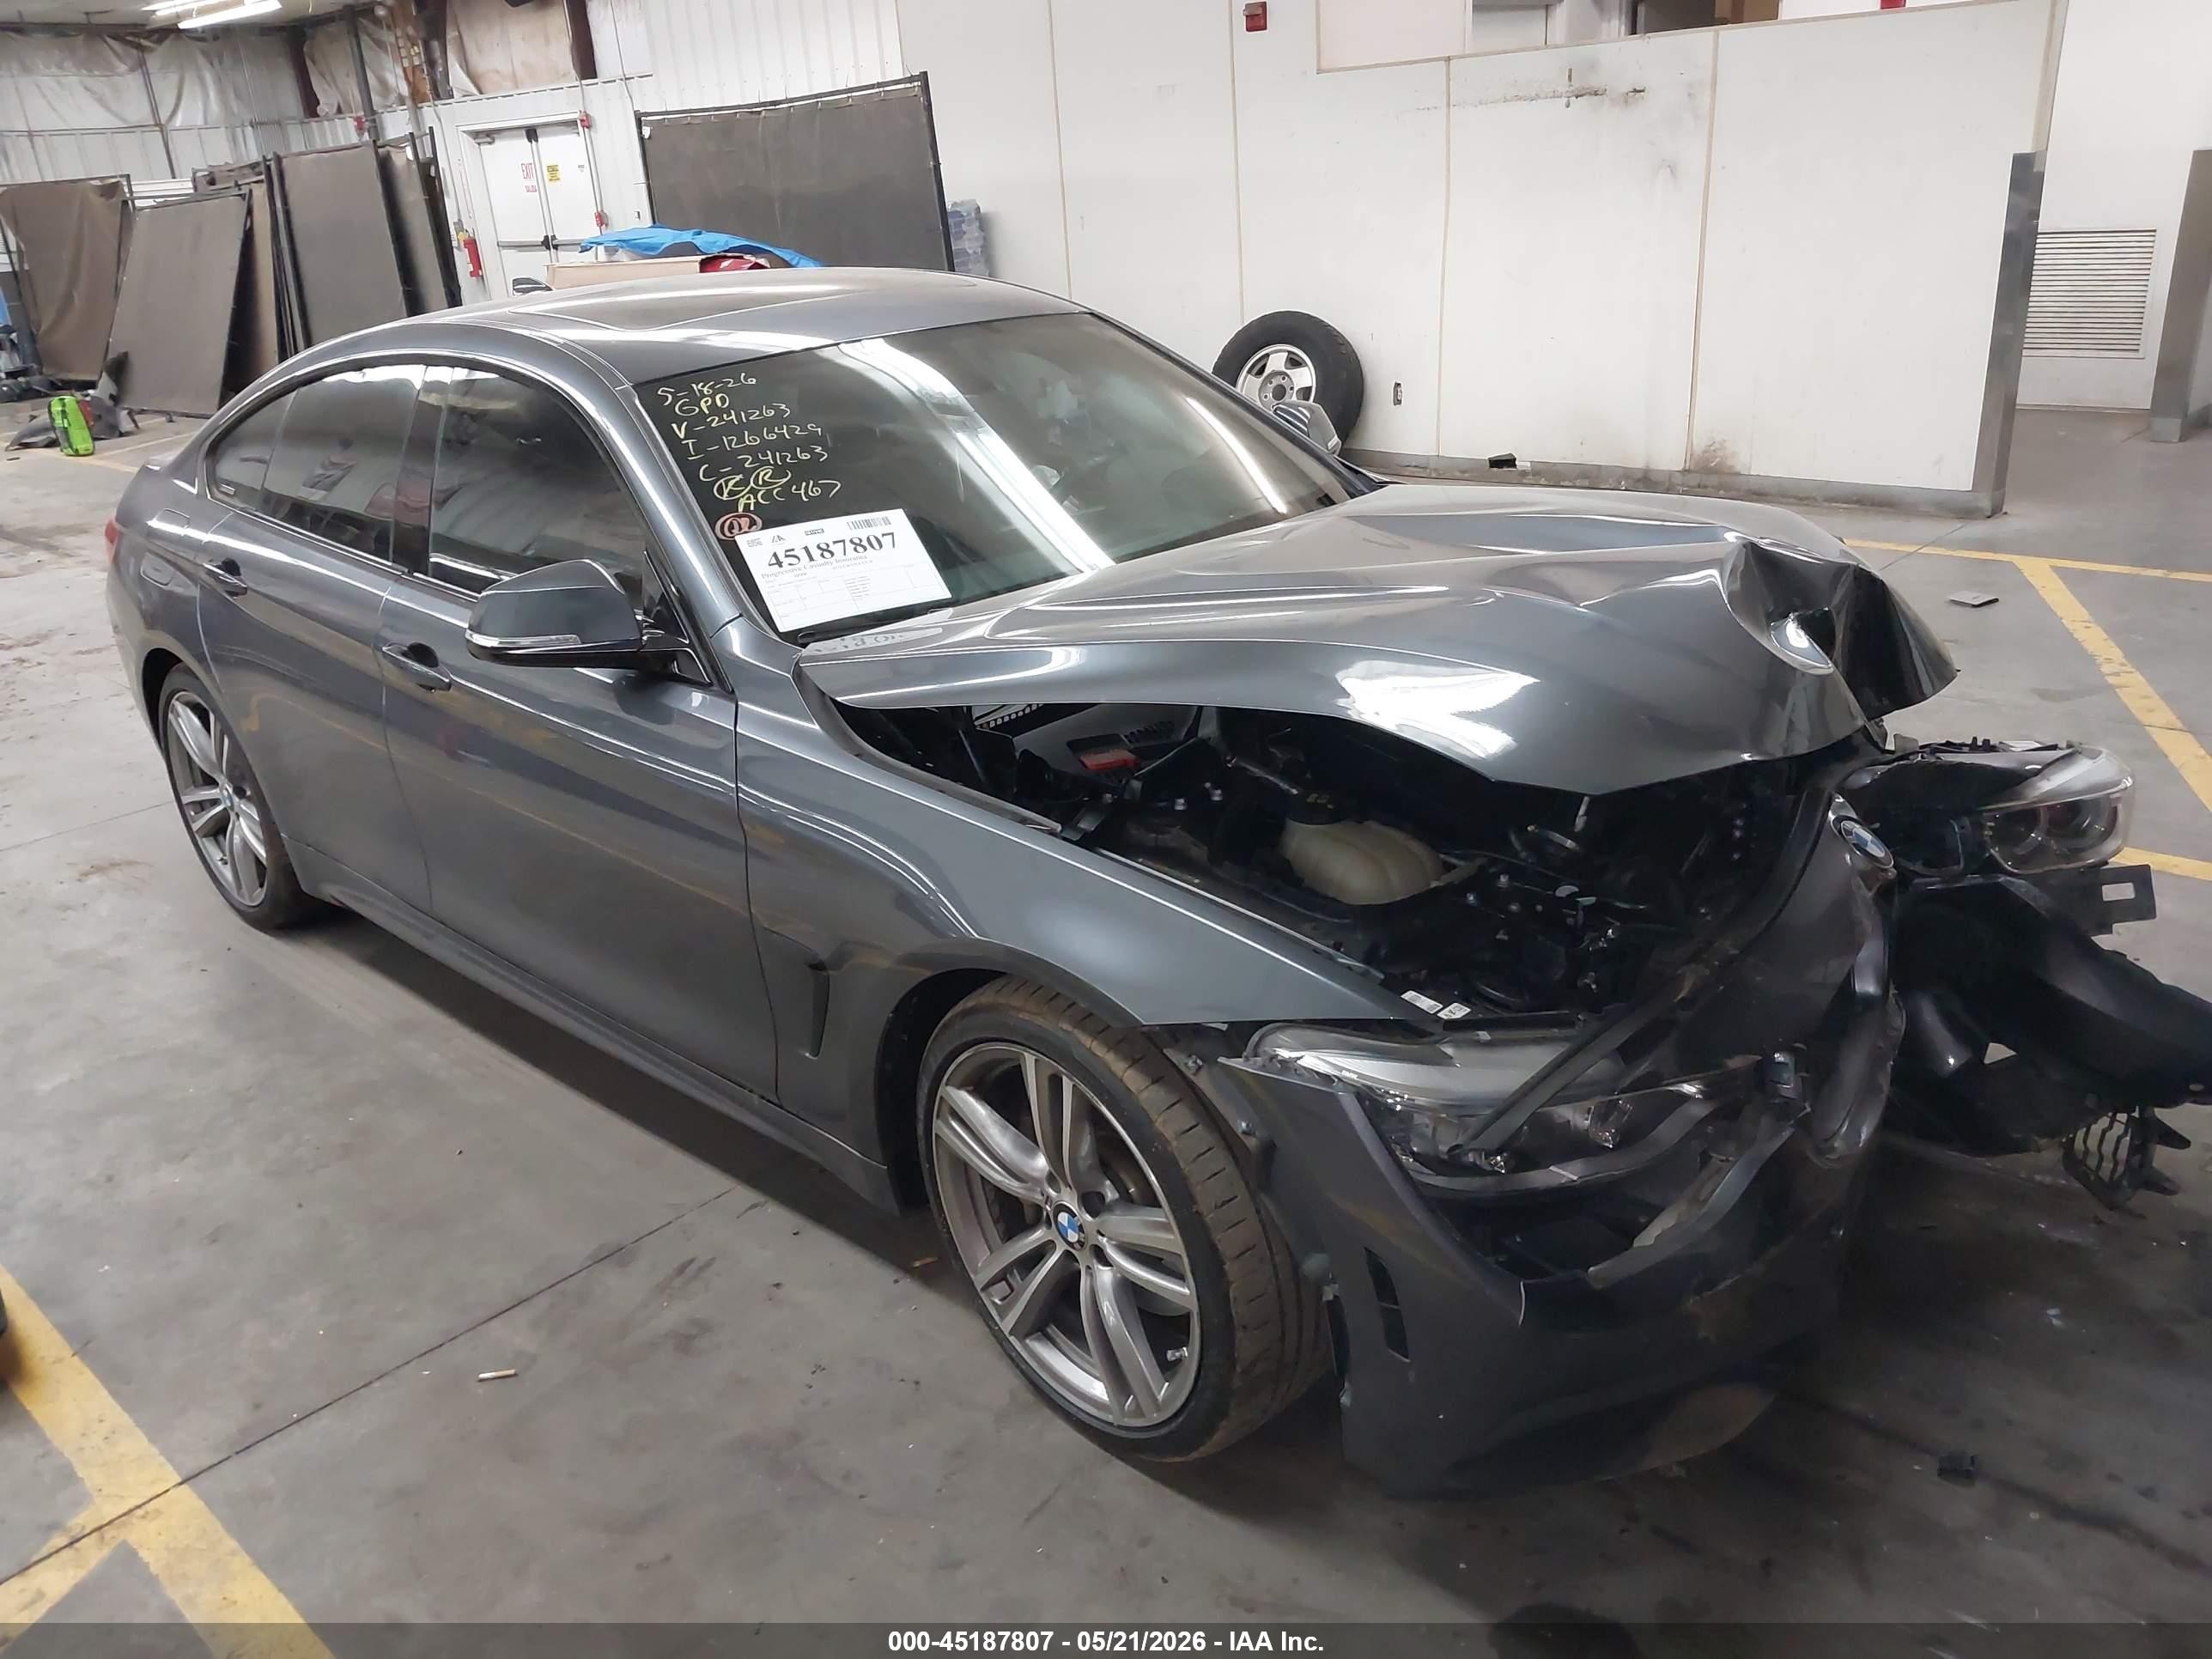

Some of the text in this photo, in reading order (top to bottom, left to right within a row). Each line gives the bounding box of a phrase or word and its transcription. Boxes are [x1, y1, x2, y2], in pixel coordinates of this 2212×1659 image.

[520, 161, 534, 179] EXIT
[675, 393, 730, 416] GPD
[792, 479, 842, 501] 467
[768, 532, 896, 569] 45187807
